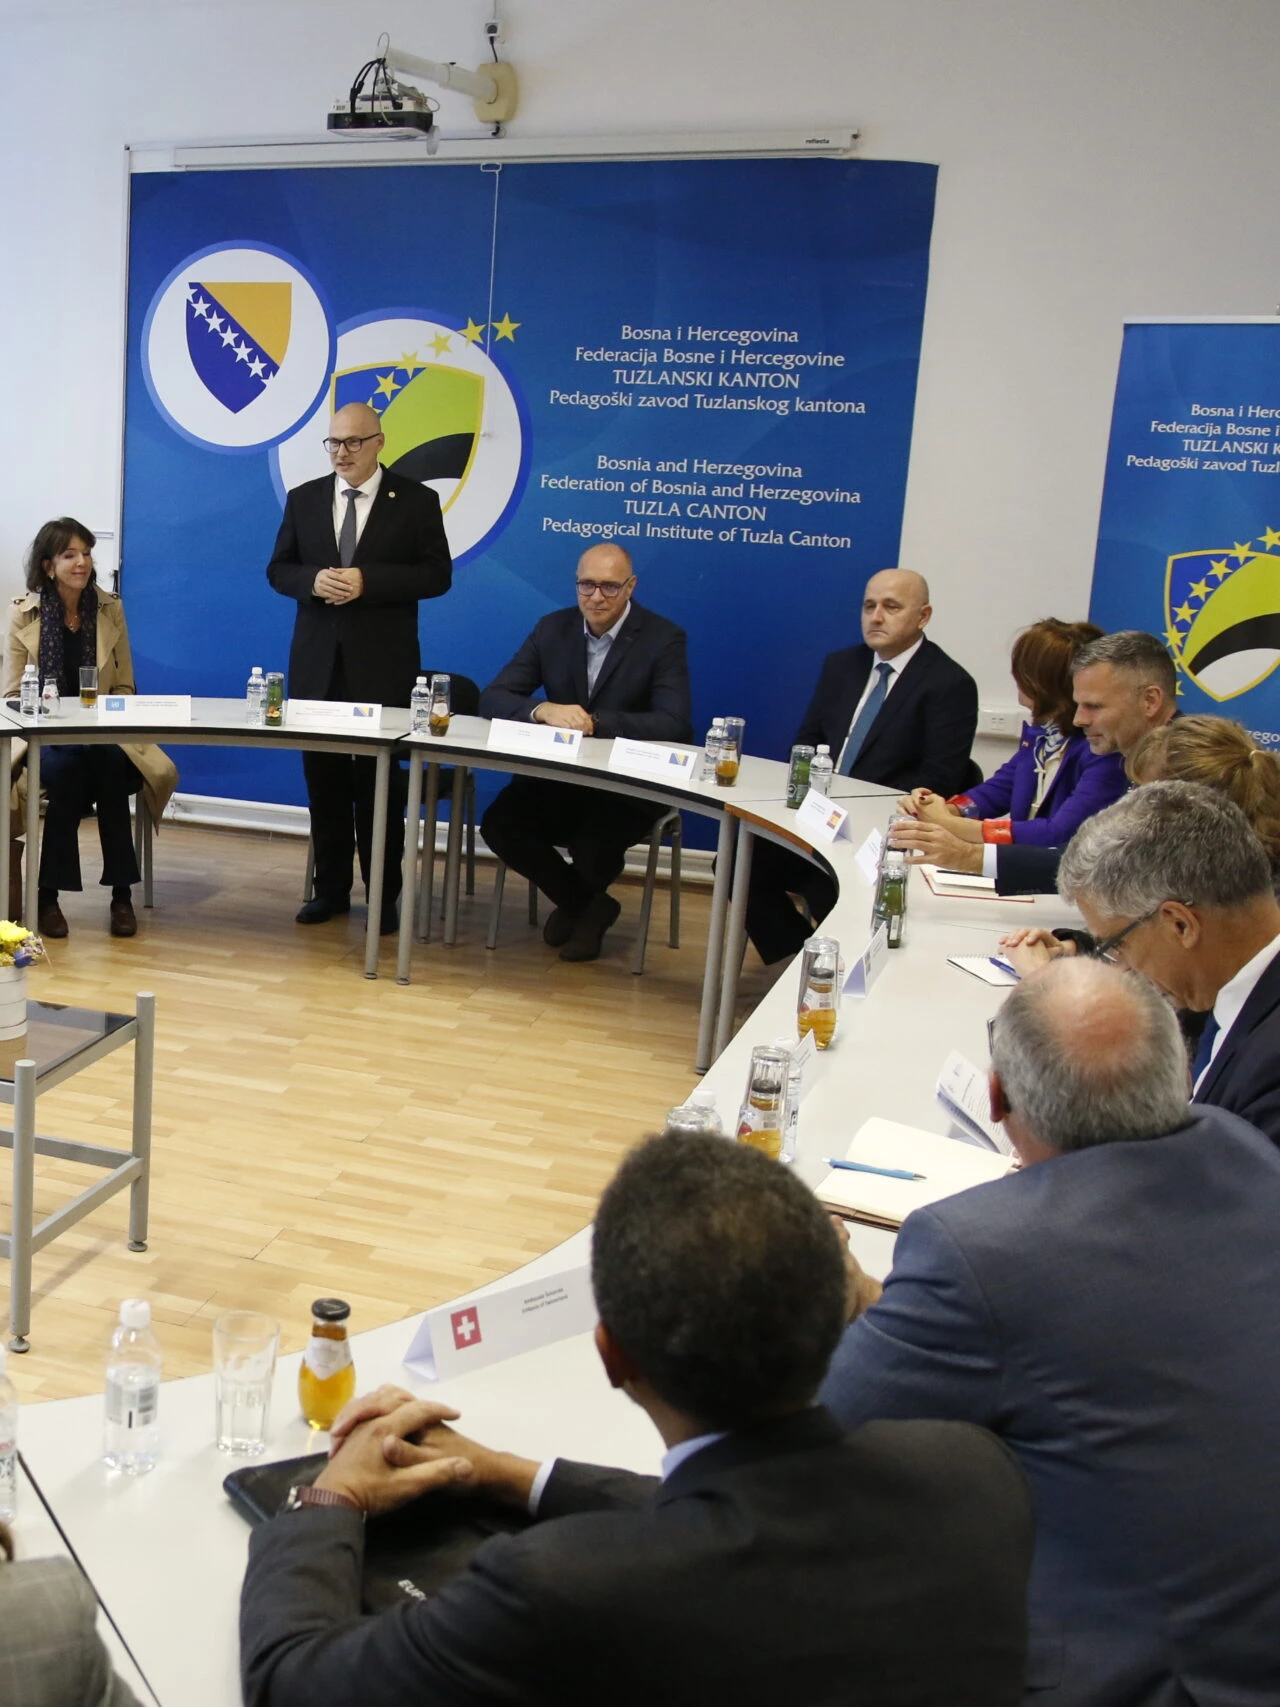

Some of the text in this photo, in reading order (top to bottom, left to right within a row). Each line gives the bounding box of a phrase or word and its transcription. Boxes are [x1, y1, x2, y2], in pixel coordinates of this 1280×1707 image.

[621, 324, 799, 347] Bosna i Hercegovina
[575, 346, 846, 371] Federacija Bosne i Hercegovine
[612, 369, 800, 389] TUZLANSKI KANTON
[549, 389, 867, 416] Pedagoški zavod Tuzlanskog kantona
[1190, 403, 1235, 417] Bosna
[1238, 405, 1244, 417] i
[1150, 420, 1221, 437] Federacija
[1226, 423, 1271, 437] Bosne
[1182, 439, 1268, 455] TUZLANSKI
[596, 454, 803, 481] Bosnia and Herzegovina
[1126, 455, 1199, 472] Pedagoški
[1202, 460, 1247, 472] zavod
[540, 473, 862, 506] Federation of Bosnia and Herzegovina
[623, 499, 767, 522] TUZLA CANTON
[542, 516, 852, 549] Pedagogical Institute of Tuzla Canton
